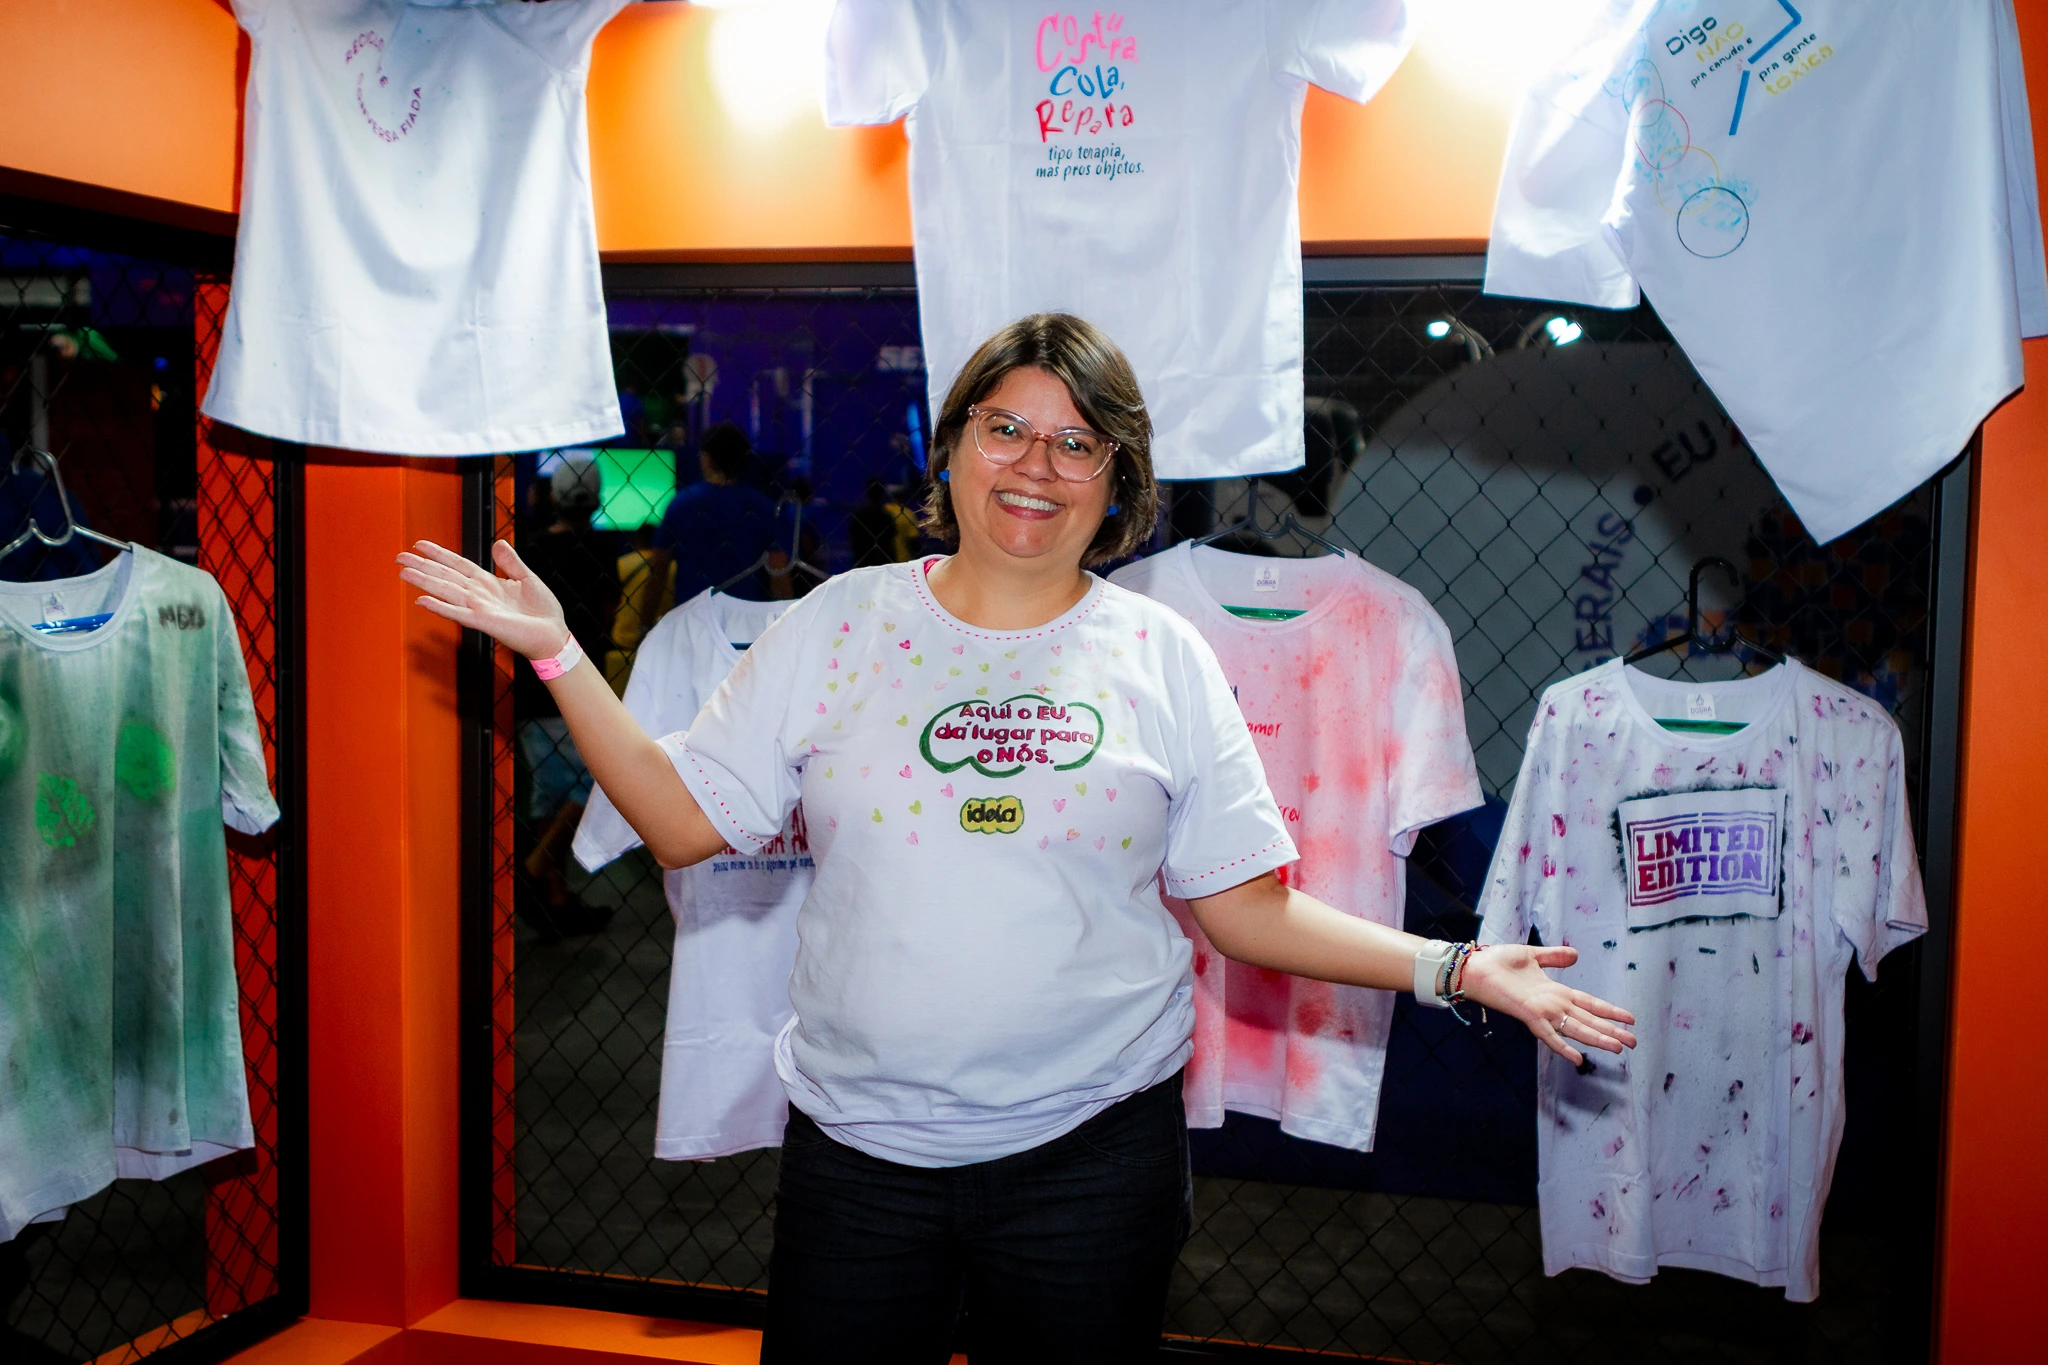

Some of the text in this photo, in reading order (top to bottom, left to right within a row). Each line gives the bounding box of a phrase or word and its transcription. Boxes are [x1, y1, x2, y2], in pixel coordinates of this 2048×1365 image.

[1665, 16, 1717, 56] Digo
[1696, 21, 1744, 63] NÃO
[1758, 33, 1817, 82] pra gente
[1690, 71, 1708, 89] pra
[400, 86, 422, 136] FIADA
[1035, 98, 1135, 143] Repara
[1035, 165, 1060, 178] mas
[1063, 164, 1092, 182] pros
[1048, 145, 1074, 165] tipo
[1651, 420, 1718, 484] EU
[934, 720, 1094, 746] dá lugar para
[959, 703, 1072, 724] Aqui o EU,
[976, 749, 994, 764] o
[1636, 824, 1765, 862] LIMITED
[1637, 852, 1763, 893] EDITION
